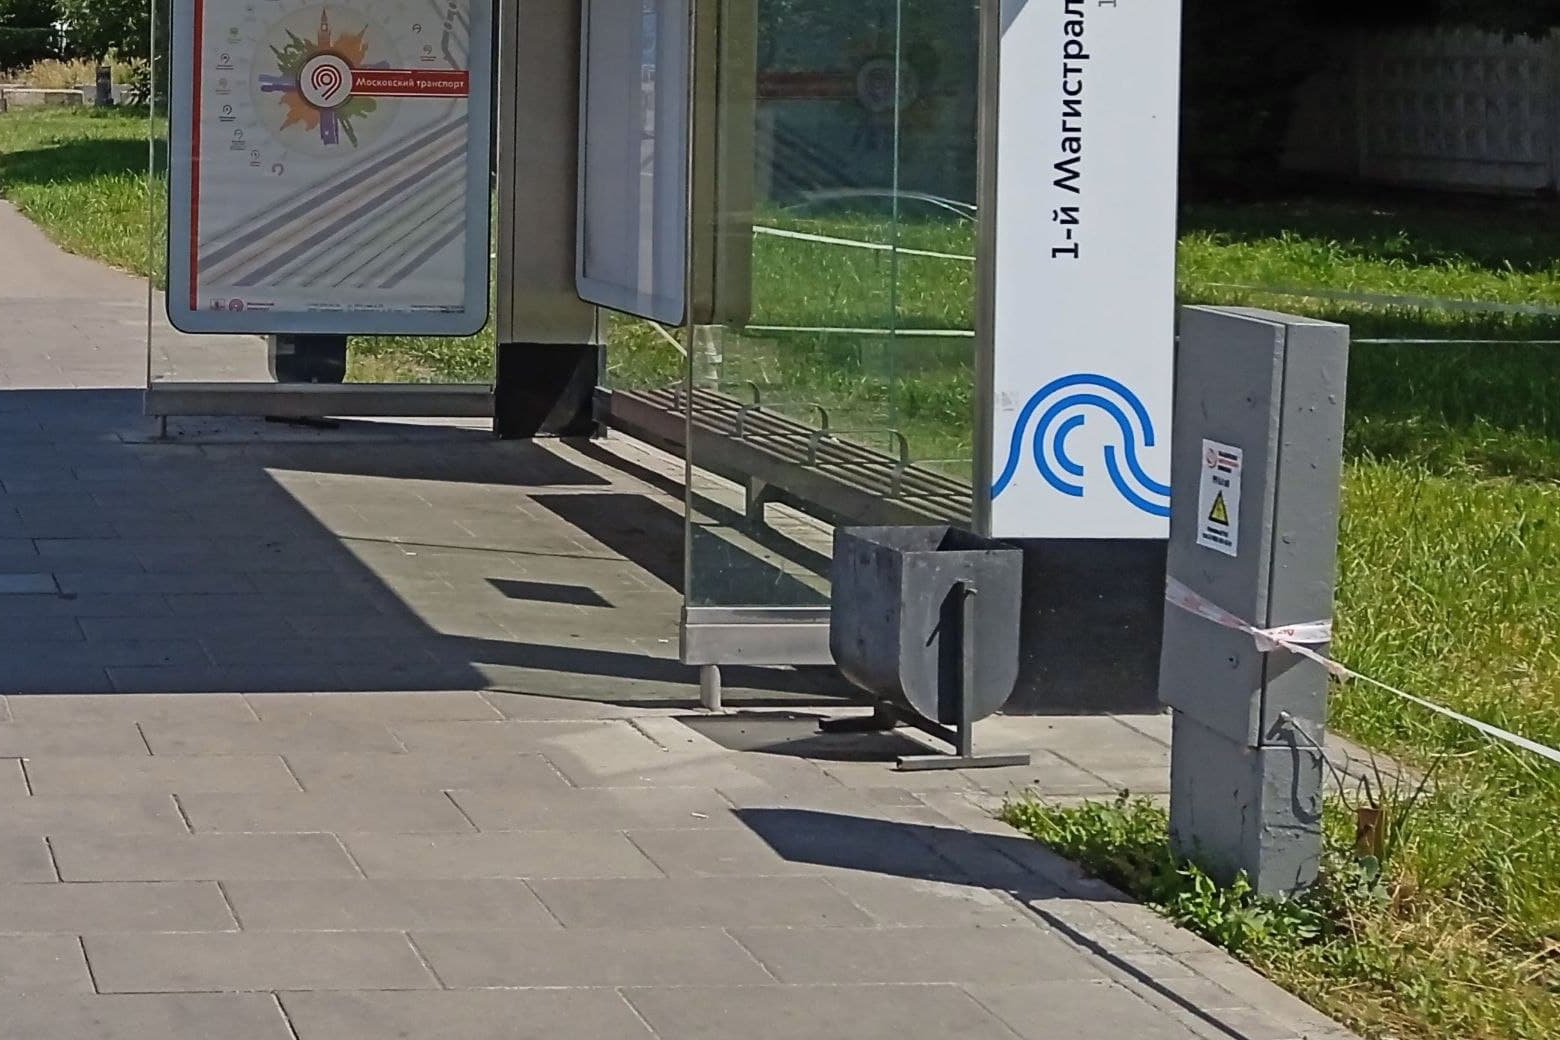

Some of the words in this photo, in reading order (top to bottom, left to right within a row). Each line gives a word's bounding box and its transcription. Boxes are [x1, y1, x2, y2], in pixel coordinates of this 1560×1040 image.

[355, 77, 415, 87] Московский
[416, 80, 465, 90] транспорт
[1051, 206, 1080, 259] 1-й
